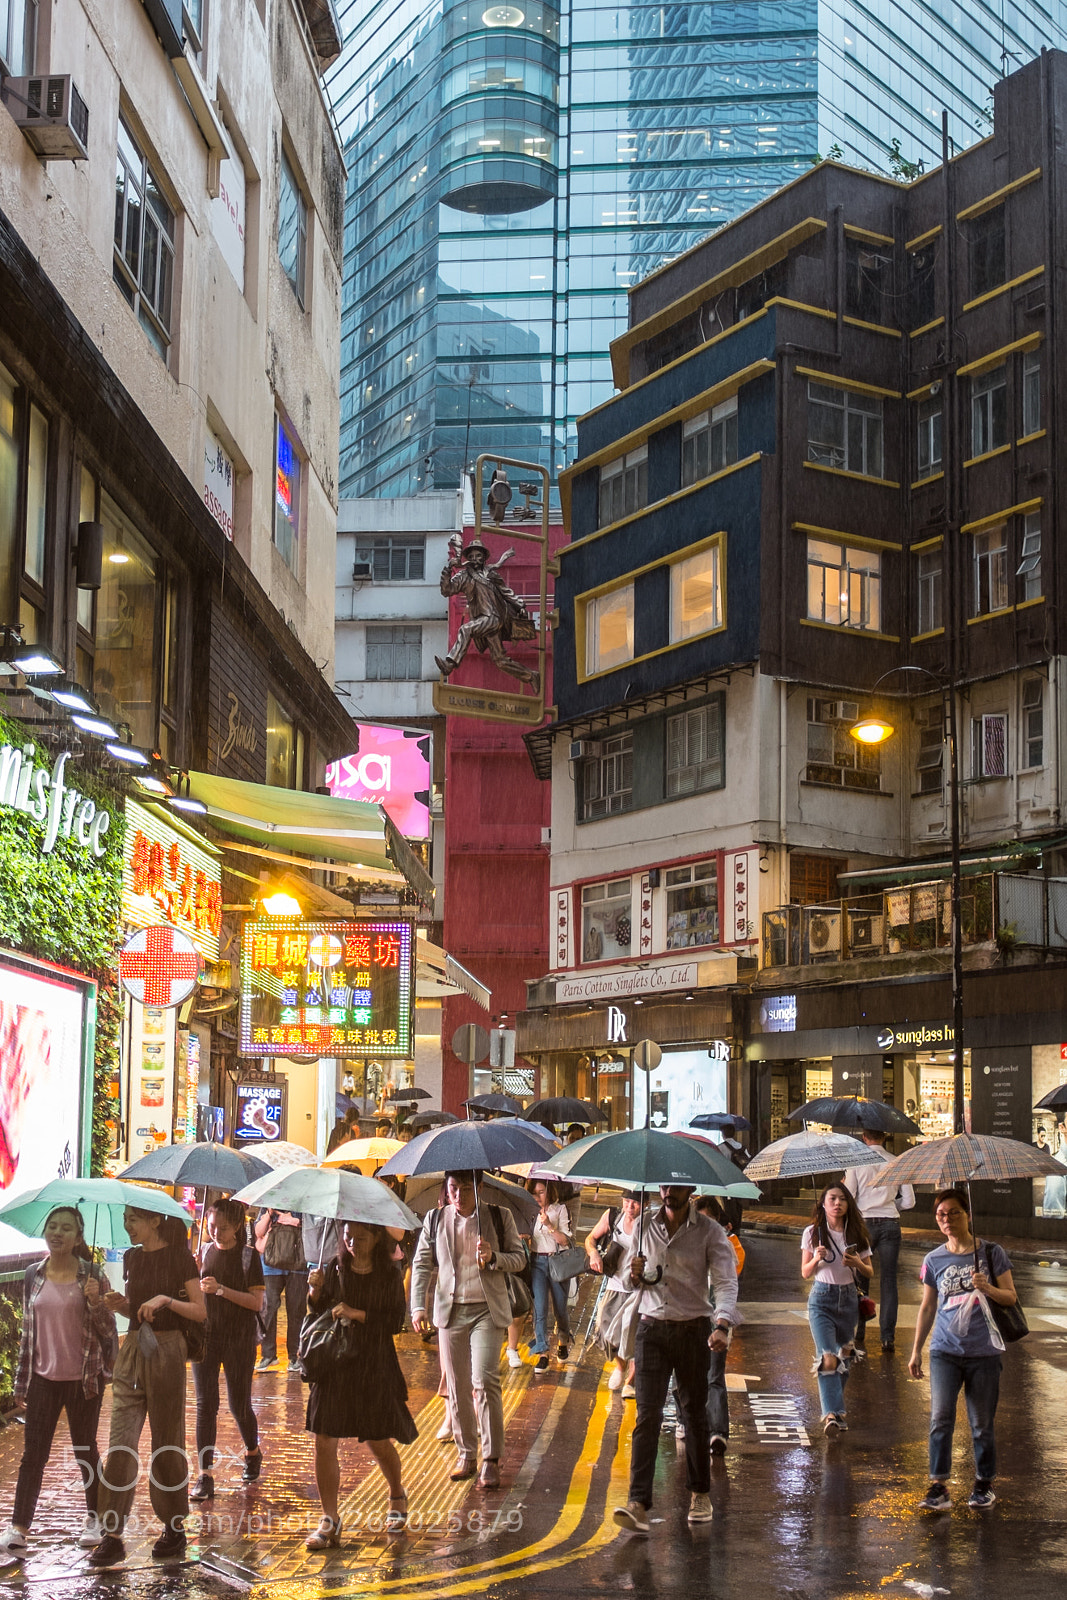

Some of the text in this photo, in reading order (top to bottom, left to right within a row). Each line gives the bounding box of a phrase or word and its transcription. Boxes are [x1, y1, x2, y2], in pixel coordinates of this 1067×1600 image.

[253, 934, 401, 968] 龍城 藥坊
[562, 966, 690, 997] Paris Cotton Singlets Co., Ltd.
[282, 989, 372, 1006] 信心保證
[330, 1028, 398, 1045] 海味批發
[896, 1026, 943, 1047] sunglass
[239, 1088, 281, 1098] MASSAGE
[267, 1106, 282, 1120] 2F
[748, 1393, 800, 1416] LOOK
[754, 1420, 812, 1446] LEFT
